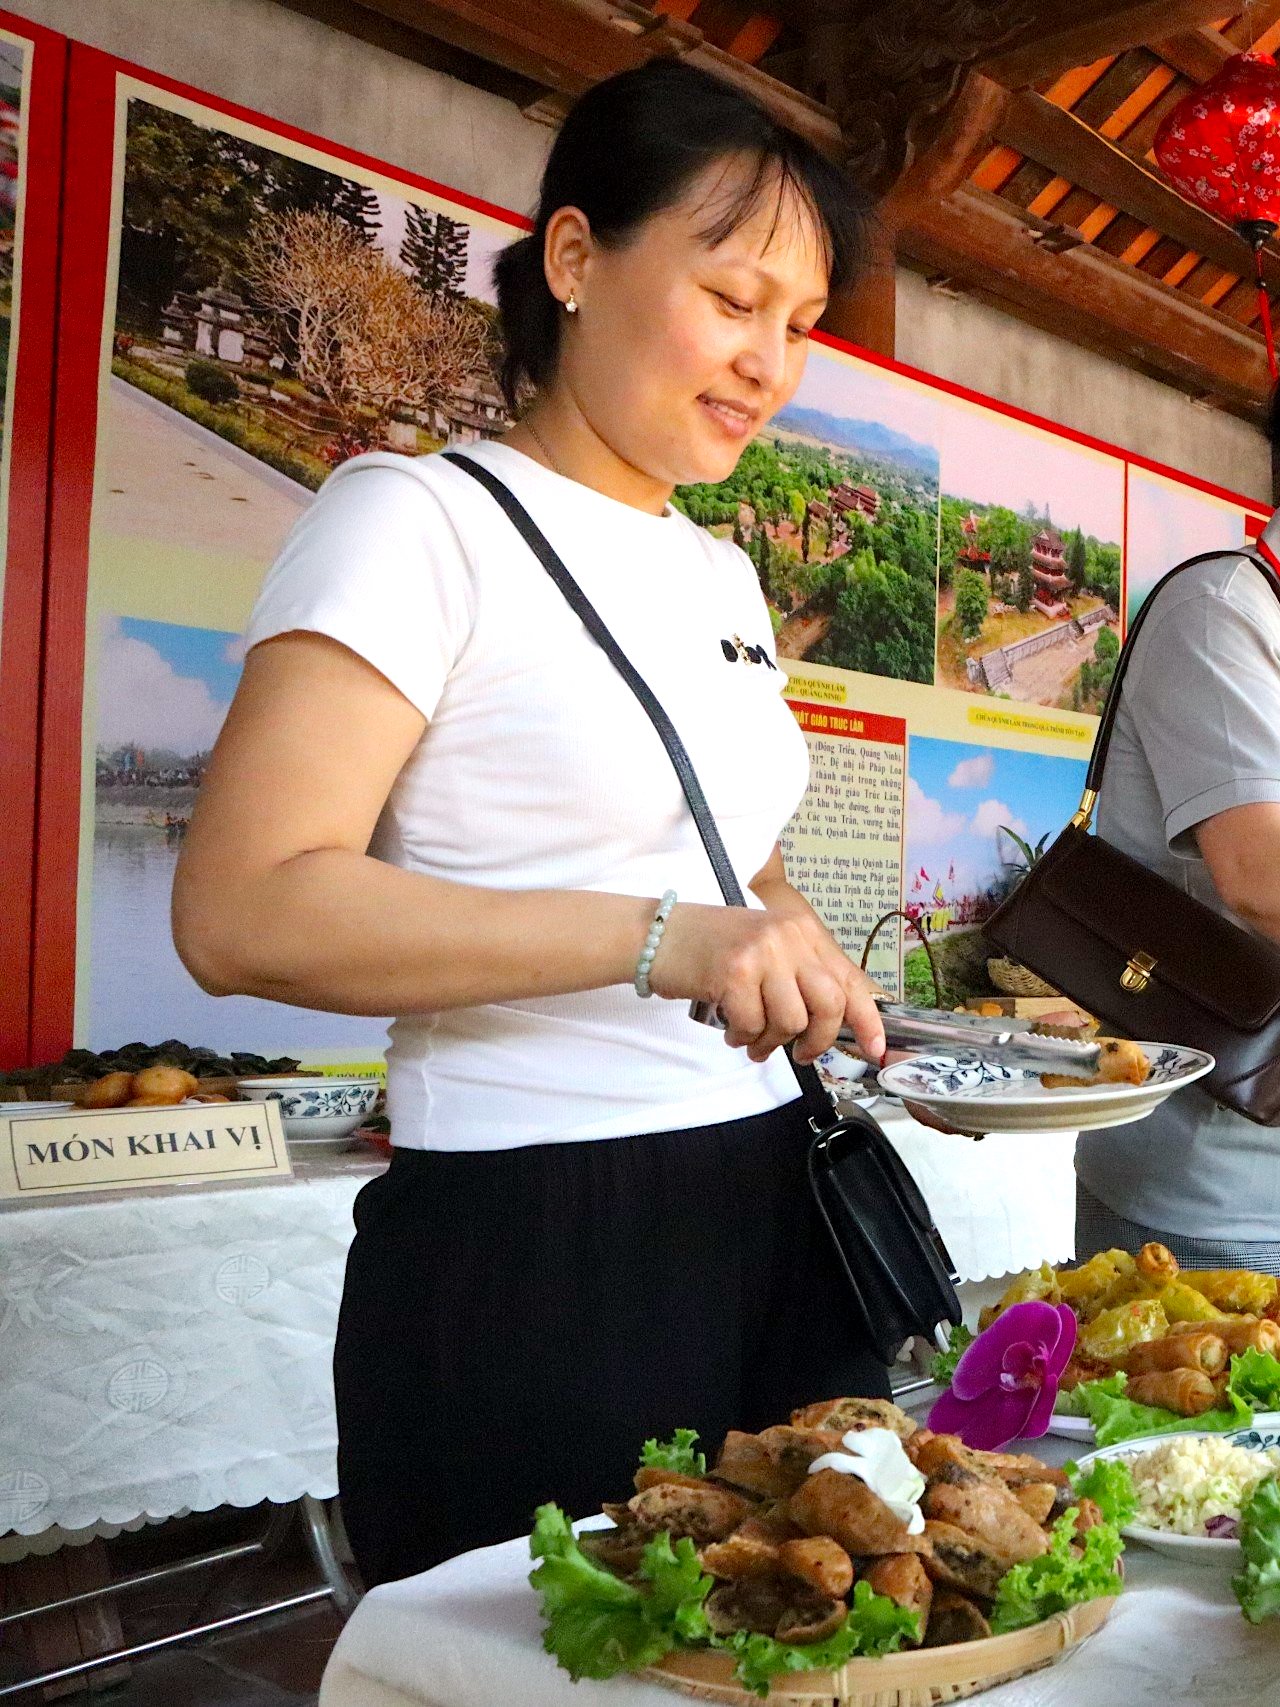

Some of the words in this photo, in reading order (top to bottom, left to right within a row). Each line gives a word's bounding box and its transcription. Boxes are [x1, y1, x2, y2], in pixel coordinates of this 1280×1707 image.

[818, 798, 830, 808] khu
[27, 1133, 116, 1166] MÓN
[127, 1128, 217, 1157] KHAI
[226, 1125, 264, 1151] VỊ
